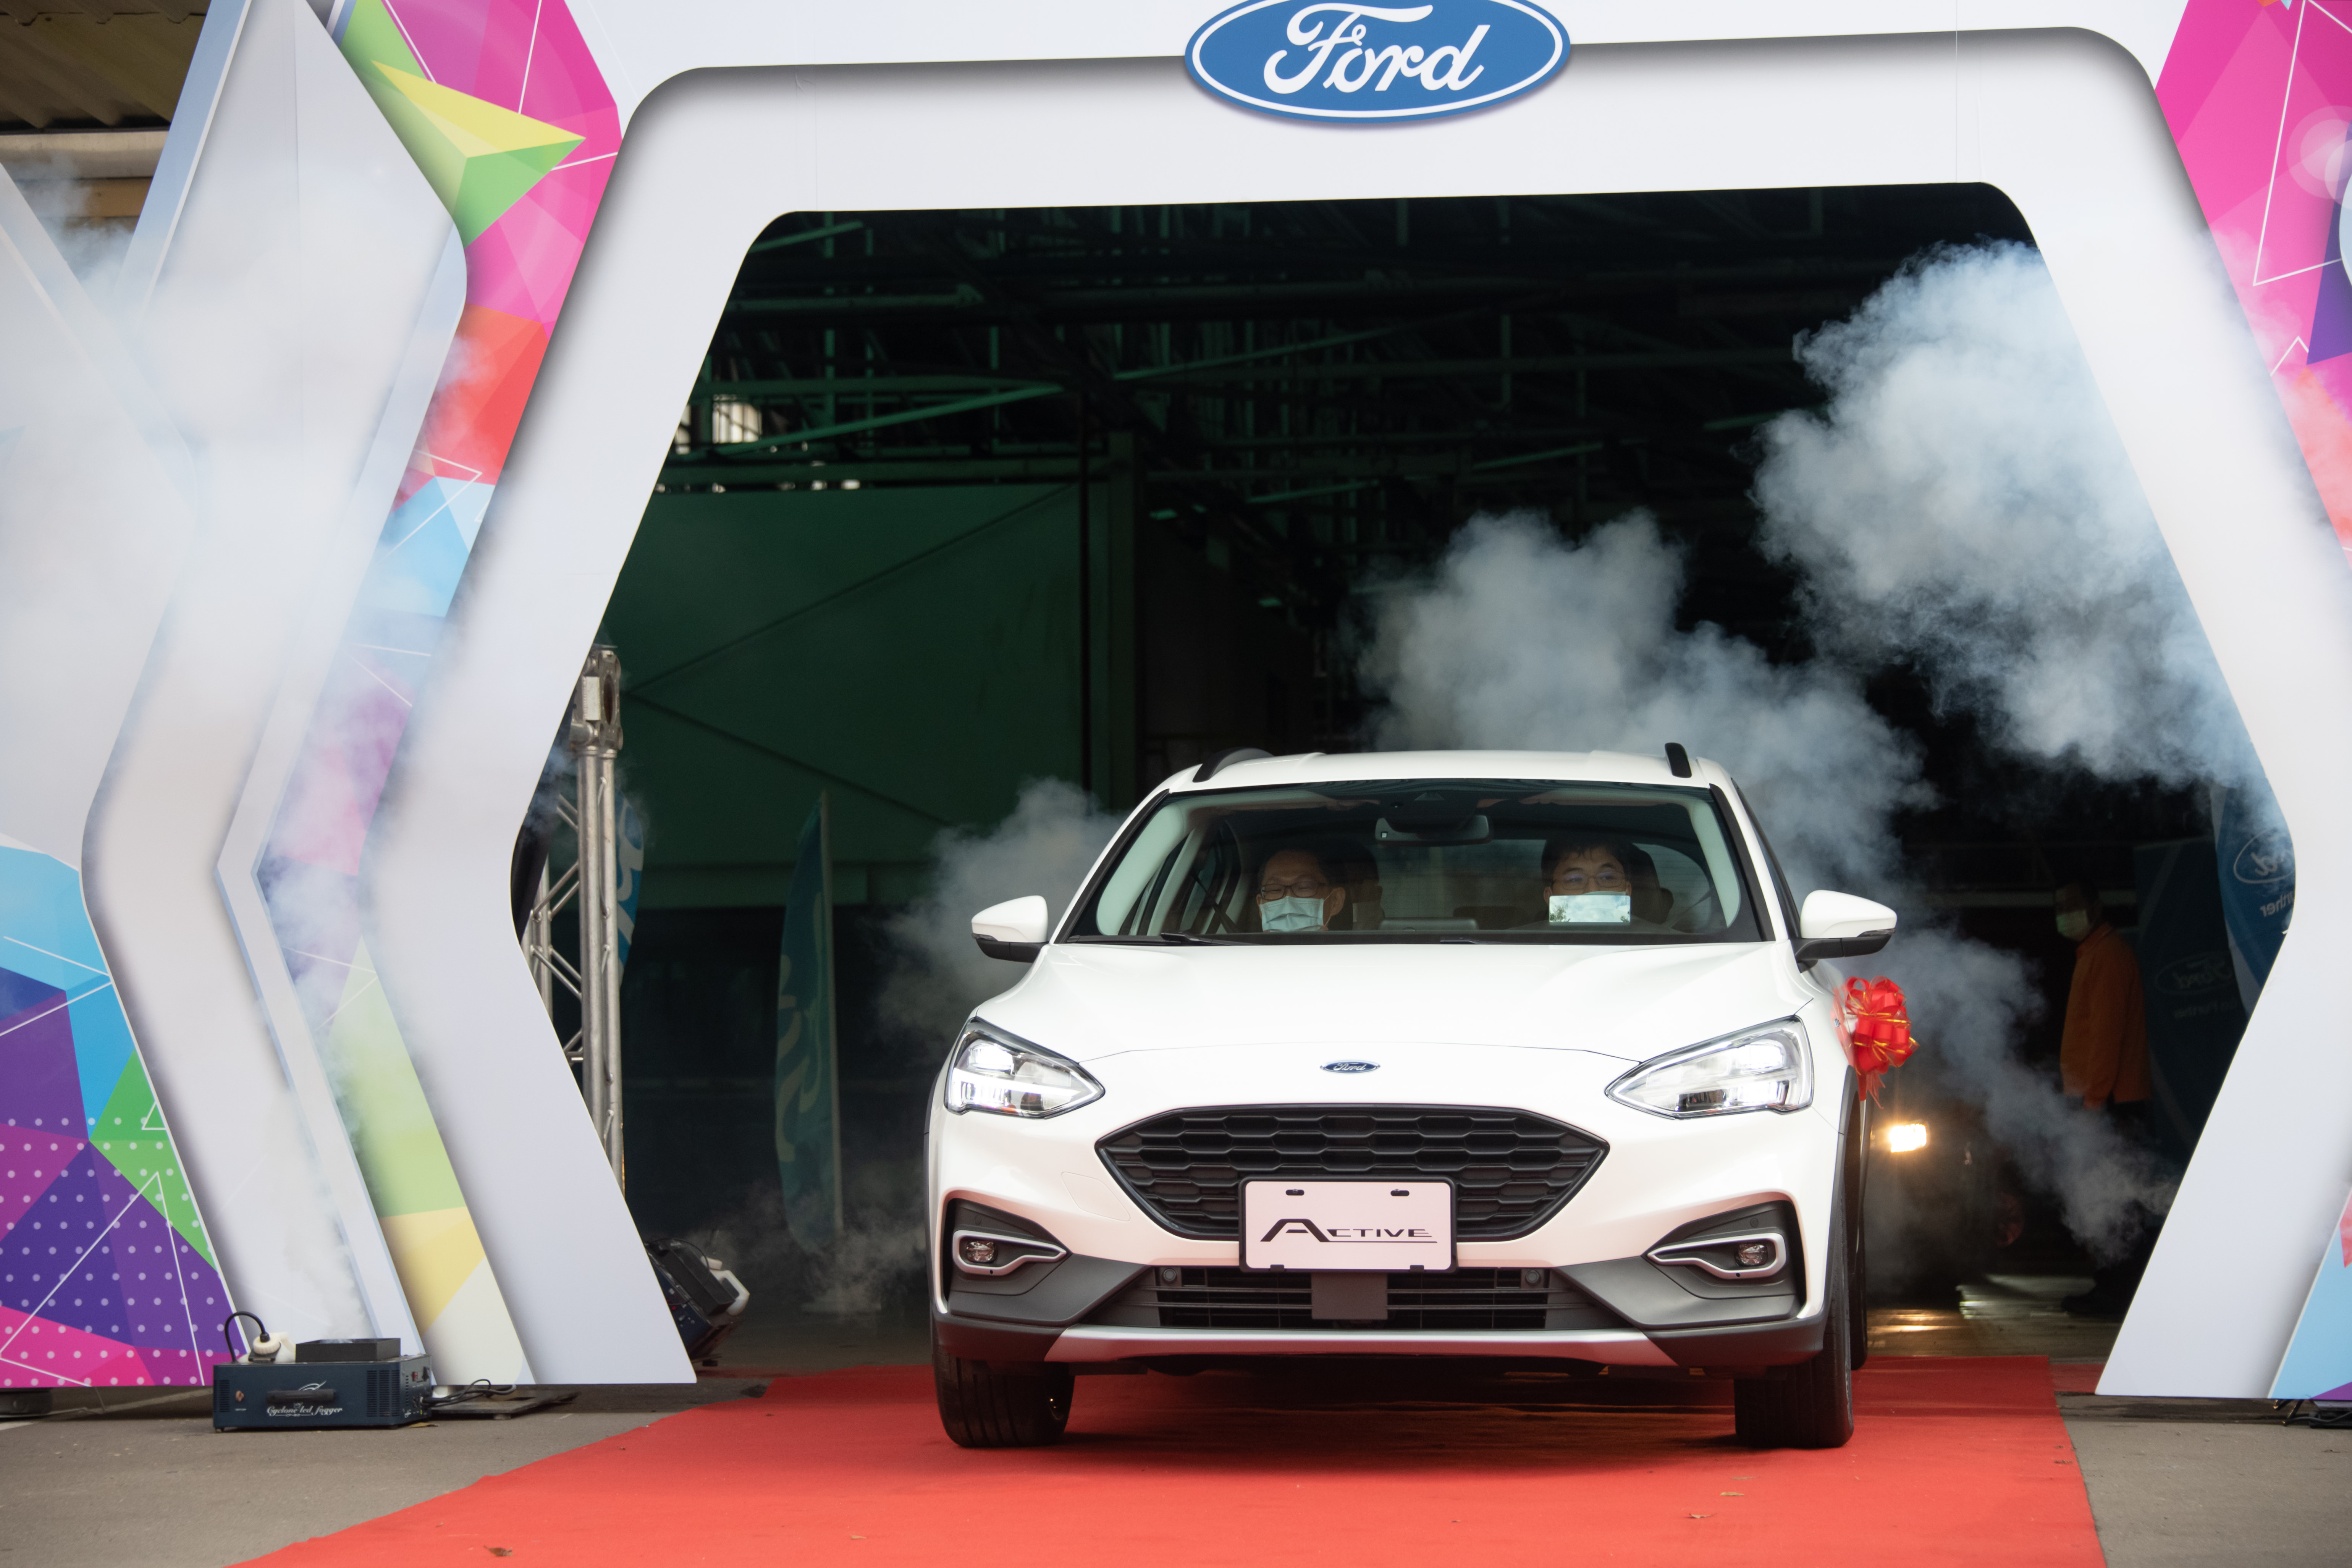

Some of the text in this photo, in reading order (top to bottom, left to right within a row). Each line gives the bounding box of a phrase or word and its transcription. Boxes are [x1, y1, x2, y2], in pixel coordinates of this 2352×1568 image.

[1263, 2, 1490, 94] Ford
[1333, 1062, 1367, 1071] Ford
[1260, 1219, 1437, 1243] ACTIVE
[267, 1406, 298, 1416] Cyclone
[311, 1405, 343, 1416] fogger
